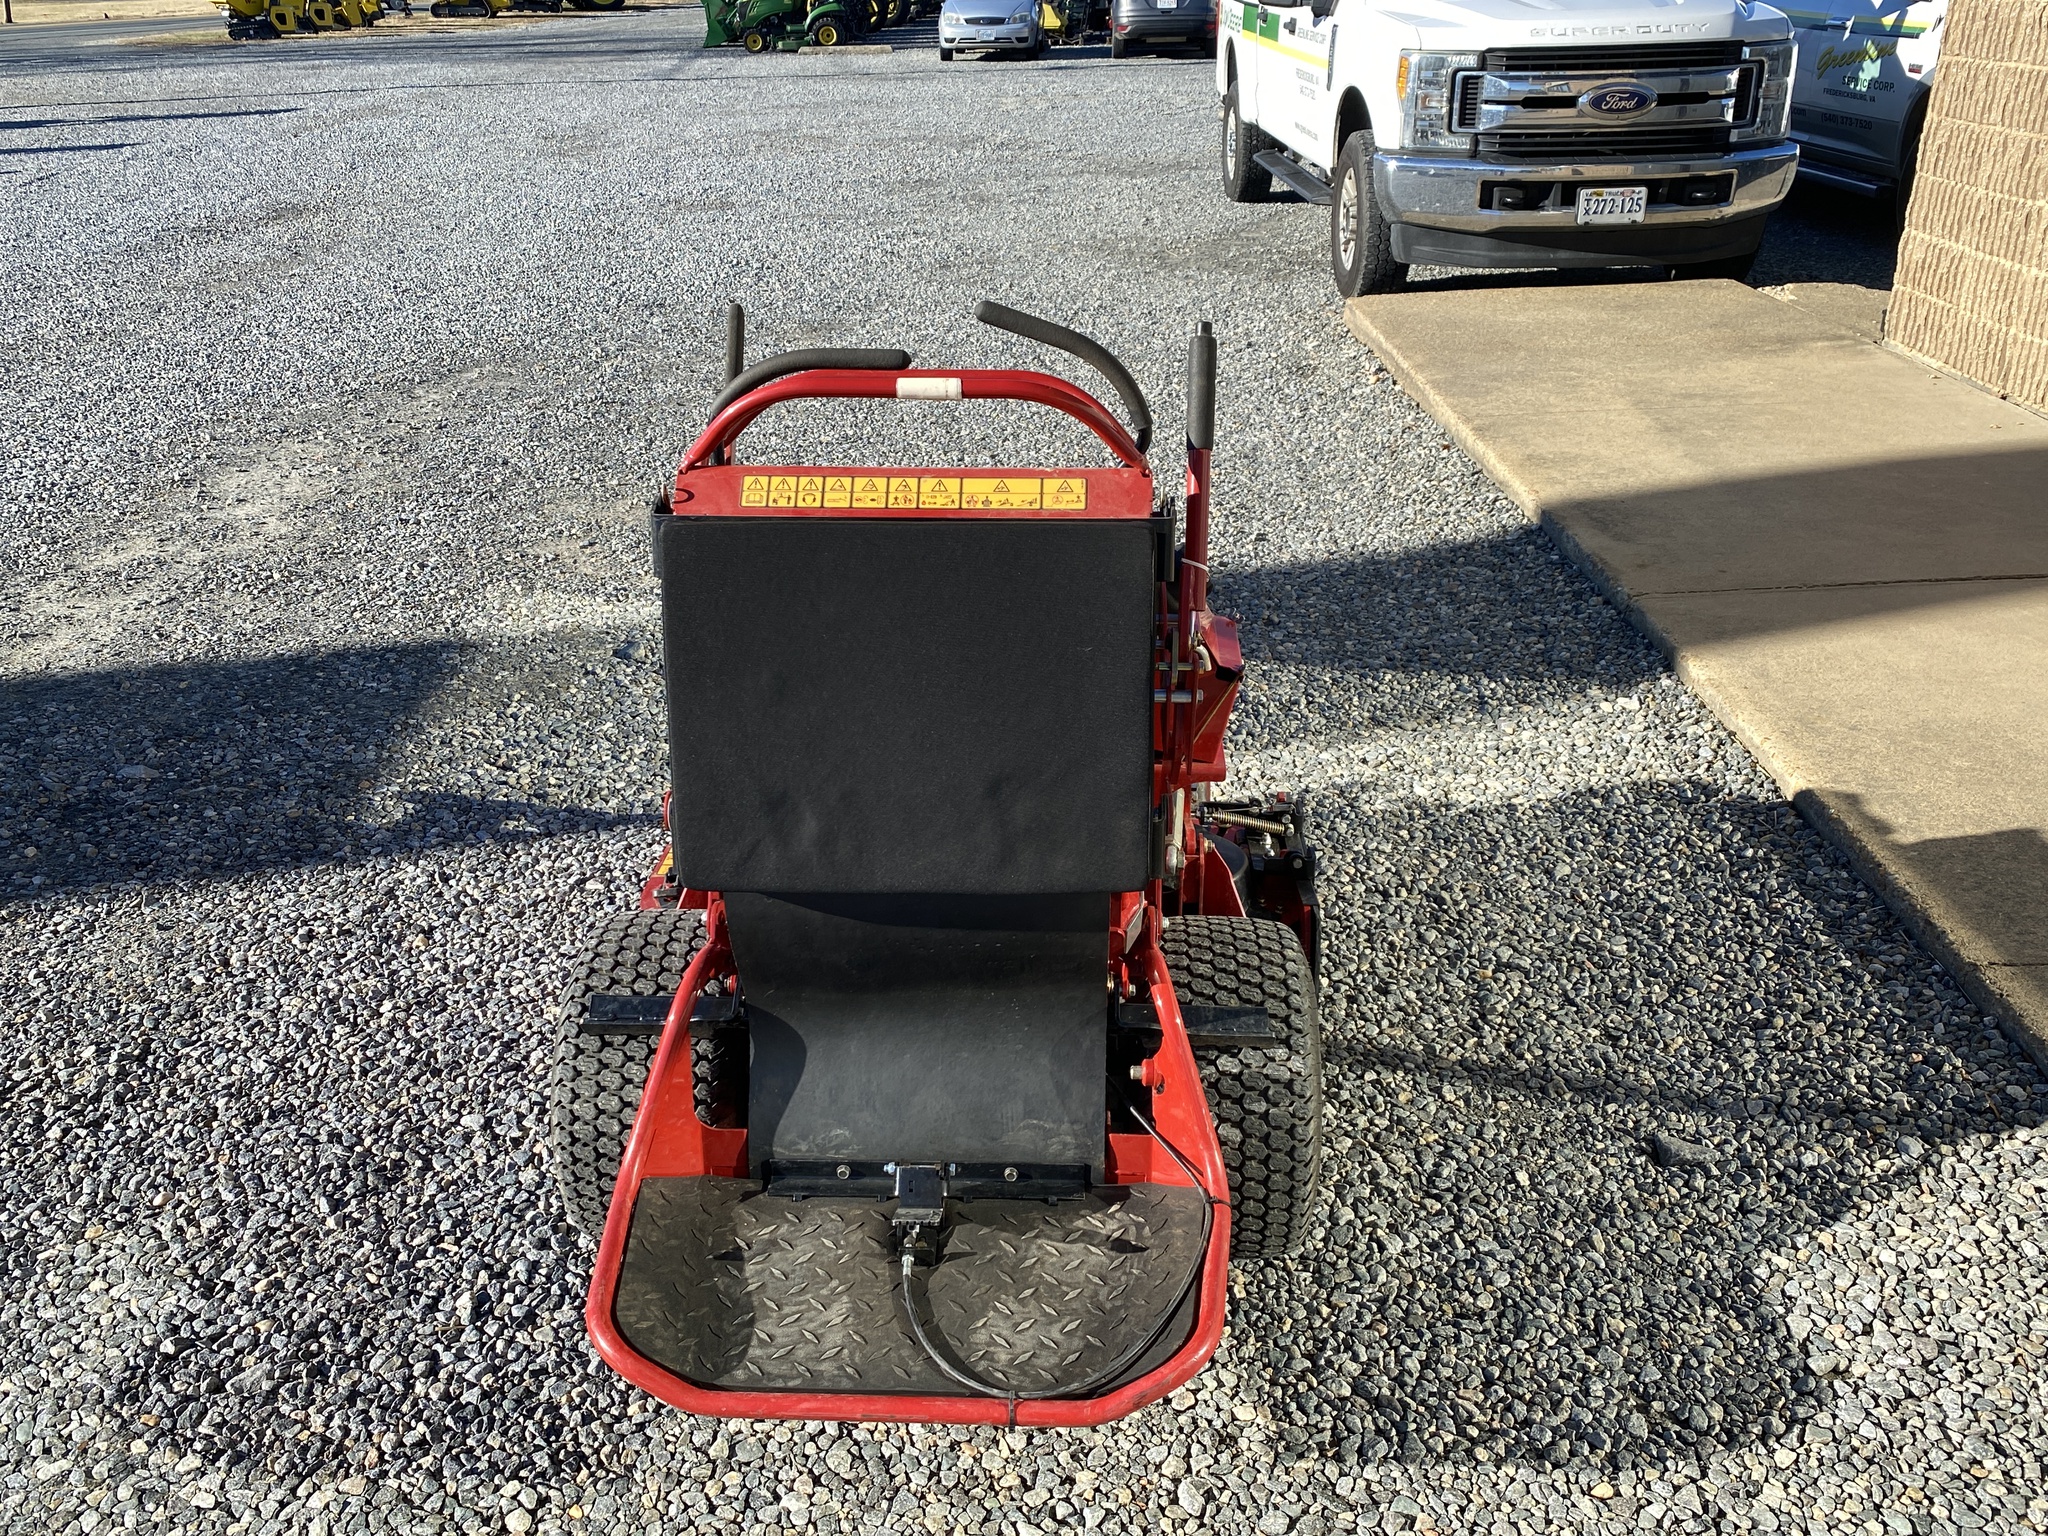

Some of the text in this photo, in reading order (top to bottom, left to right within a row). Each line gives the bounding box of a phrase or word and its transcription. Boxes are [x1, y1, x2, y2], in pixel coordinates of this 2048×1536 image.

[1530, 22, 1710, 37] SUPER DUTY
[1842, 75, 1896, 94] SERVICE CORP.
[1601, 92, 1639, 110] Ford
[1869, 95, 1876, 103] VA
[1840, 116, 1873, 131] 373-7520
[1592, 197, 1643, 215] 272-125
